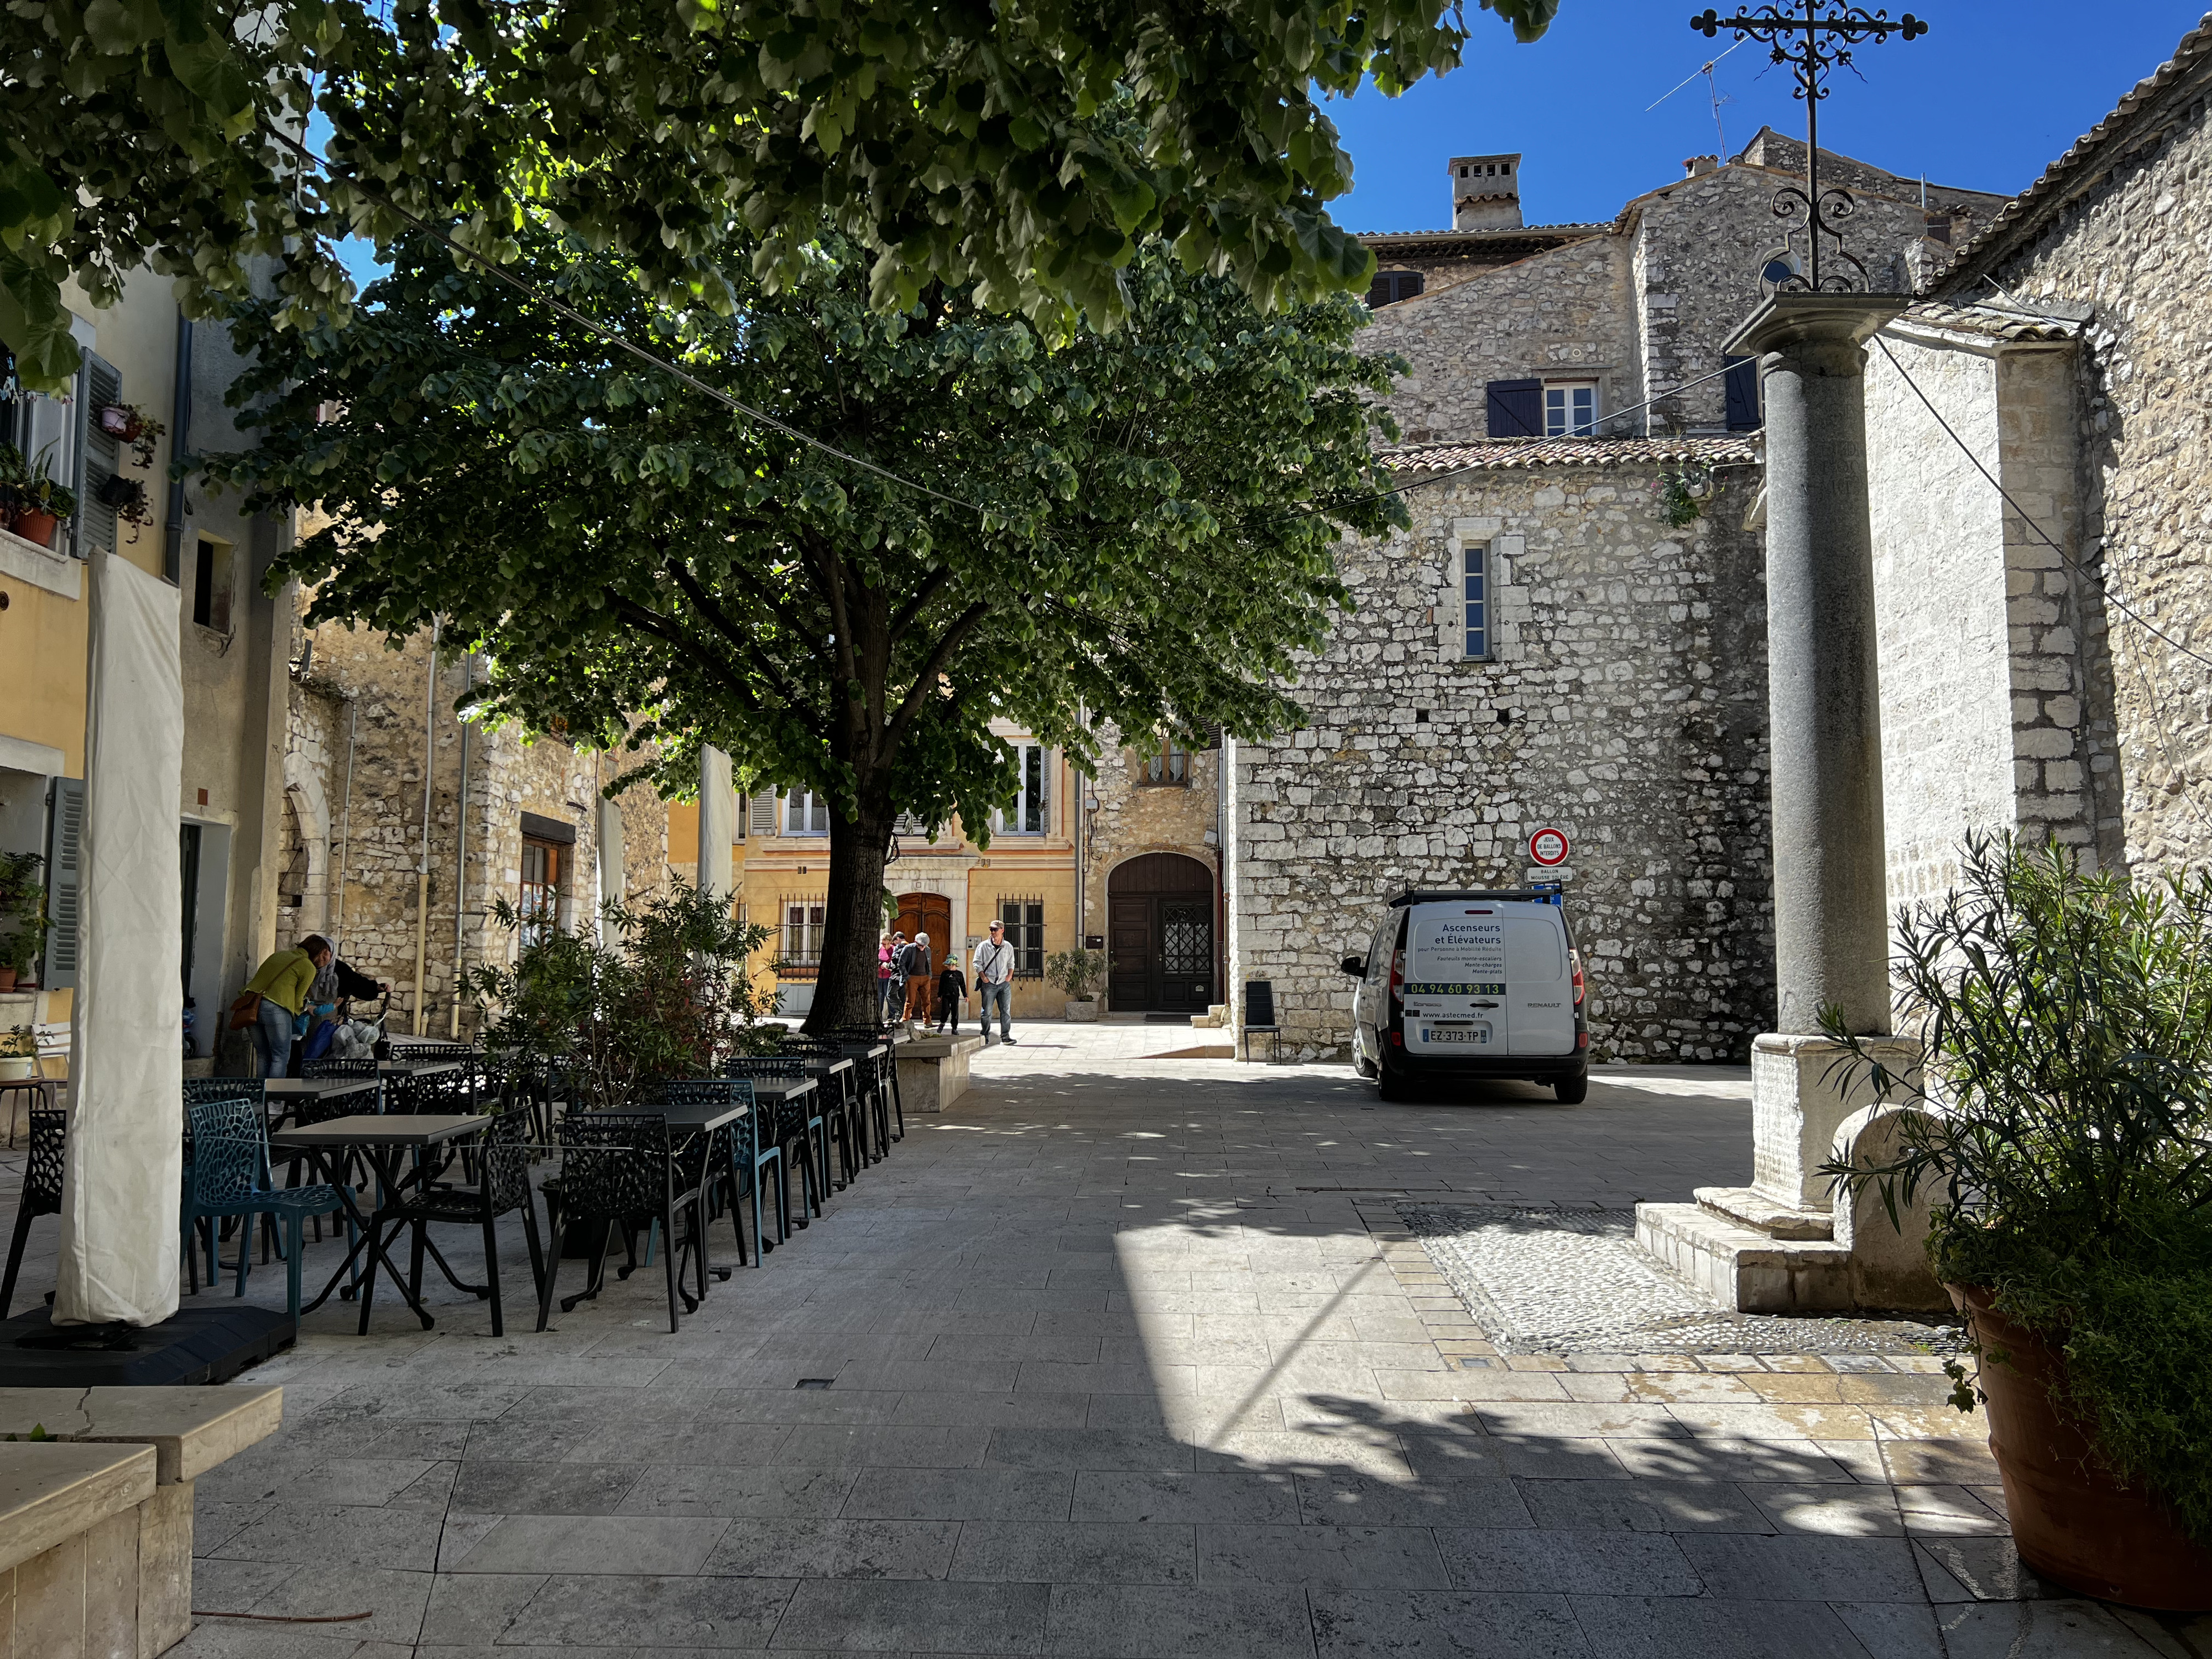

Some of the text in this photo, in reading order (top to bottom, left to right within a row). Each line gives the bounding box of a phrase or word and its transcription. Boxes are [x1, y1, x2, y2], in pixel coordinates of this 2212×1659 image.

[1442, 924, 1500, 932] Ascenseurs
[1447, 933, 1501, 944] Élévateurs
[1411, 984, 1499, 994] 04 94 60 93 13
[1431, 1031, 1478, 1041] EZ-373-TP
